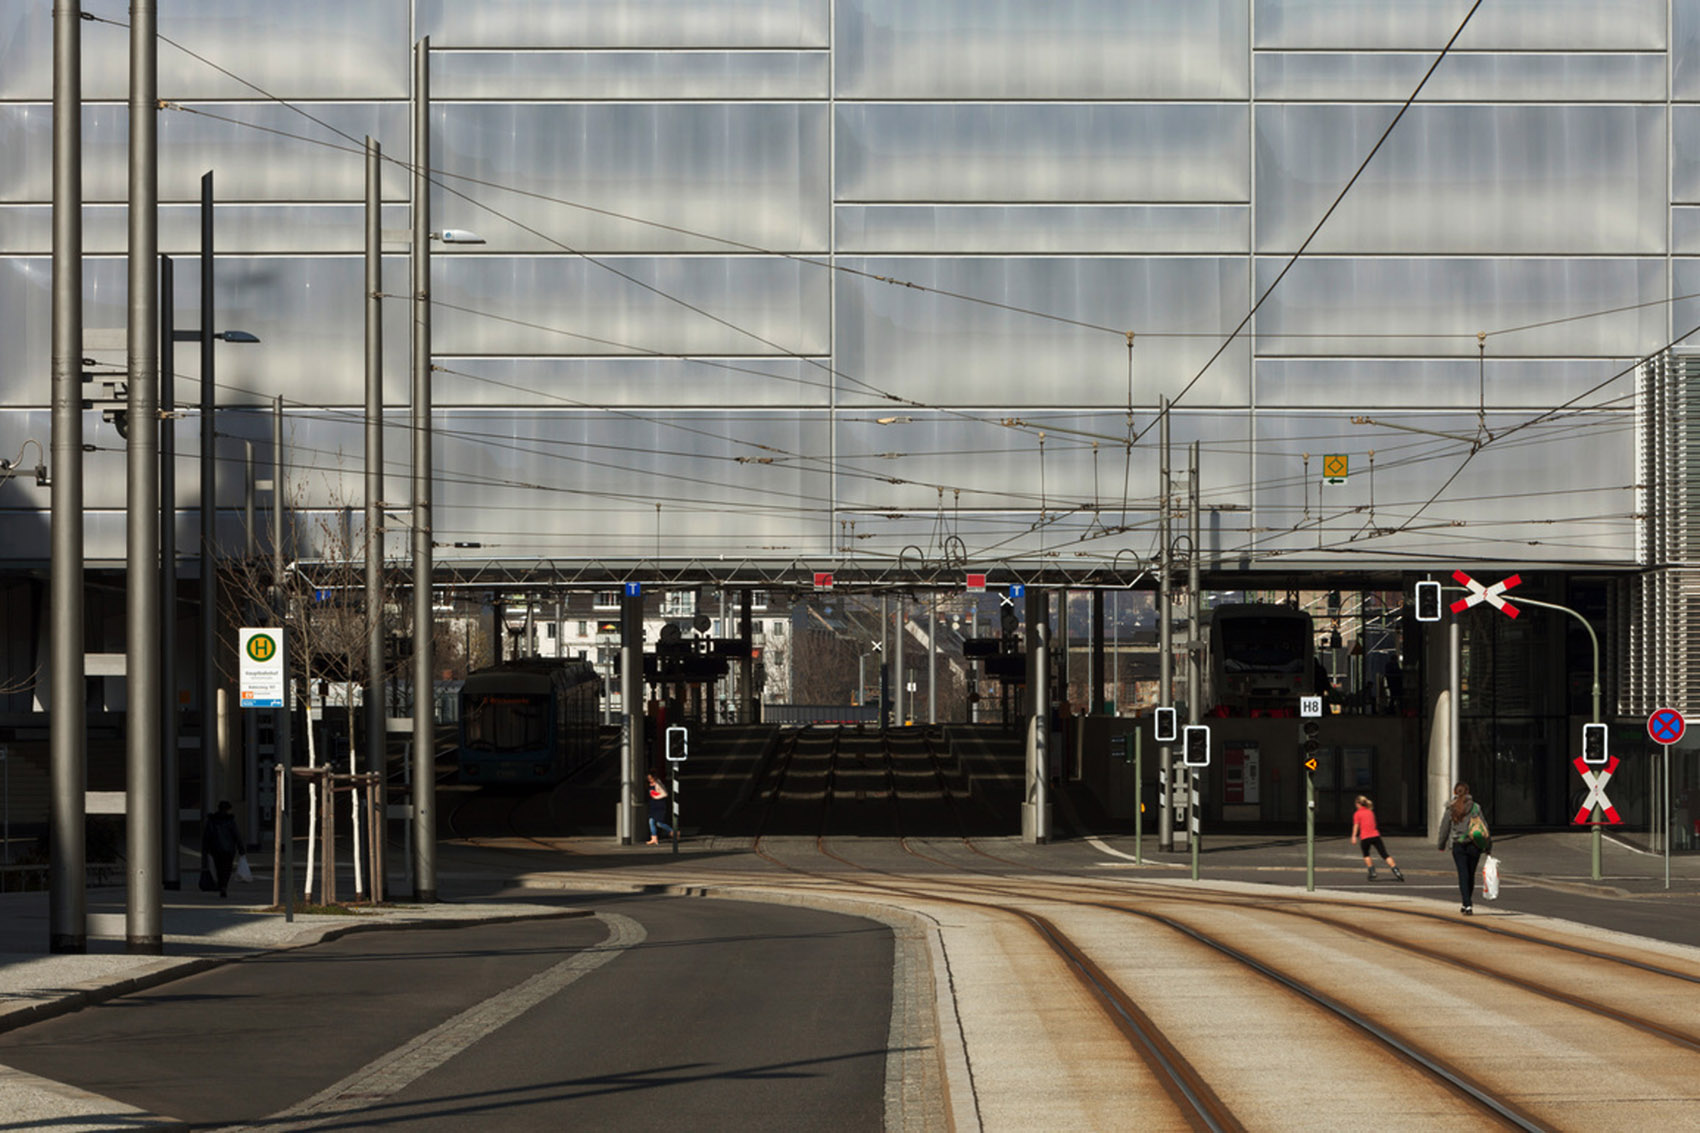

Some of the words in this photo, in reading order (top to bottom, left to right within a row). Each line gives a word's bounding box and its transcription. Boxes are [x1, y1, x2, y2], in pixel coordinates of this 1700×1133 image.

[629, 584, 637, 595] T
[1013, 586, 1021, 596] T
[256, 640, 267, 655] H
[1304, 701, 1318, 712] H8
